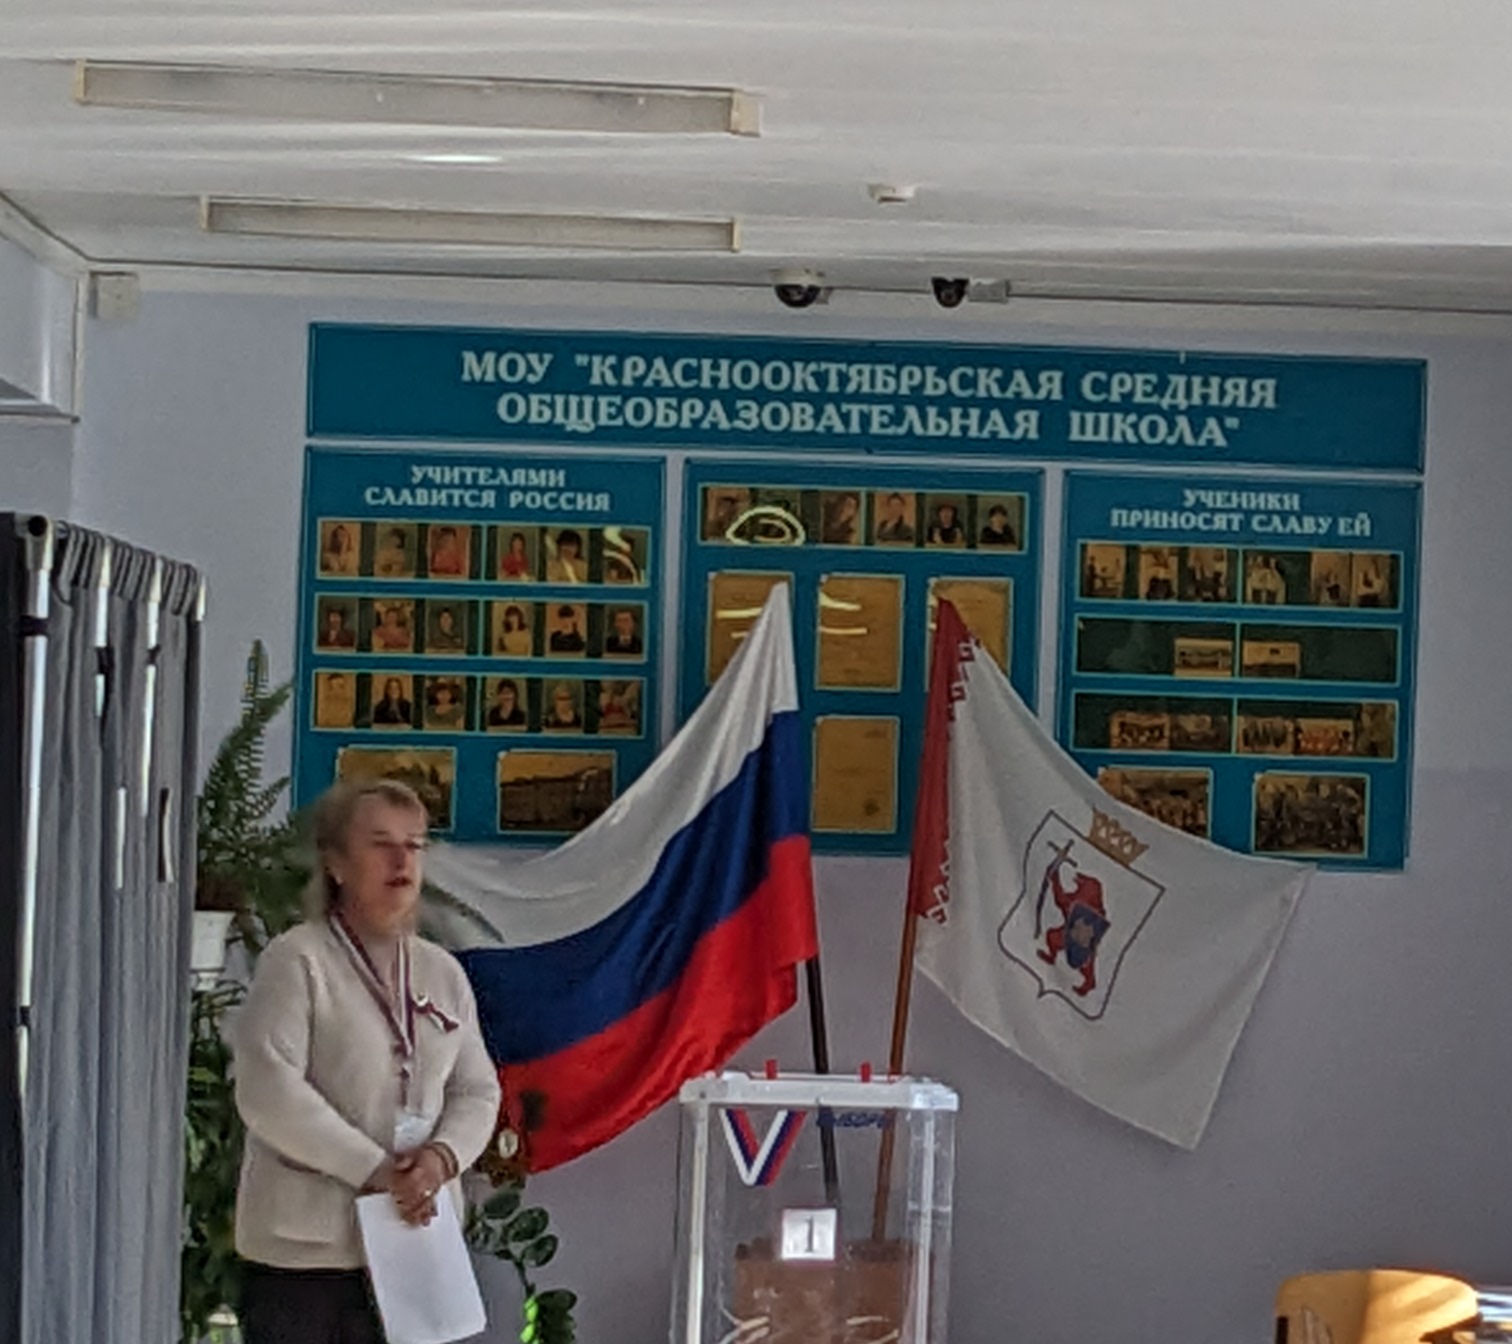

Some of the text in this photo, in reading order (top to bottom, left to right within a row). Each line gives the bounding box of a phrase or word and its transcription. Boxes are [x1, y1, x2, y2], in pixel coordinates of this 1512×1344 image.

[461, 351, 1277, 409] МОУ "КРАСНООКТЯБРЬСКАЯ СРЕДНЯЯ
[497, 392, 1239, 447] ОБЩЕОБРАЗОВАТЕЛЬНАЯ ШКОЛА"
[411, 465, 566, 487] УЧИТЕЛЯМИ
[364, 487, 610, 511] СЛАВИТСЯ РОССИЯ
[1183, 489, 1300, 511] УЧЕНИКИ
[1111, 508, 1371, 536] ПРИНОСЯТ СЛАВУ ЕЙ
[805, 1216, 814, 1253] 1
